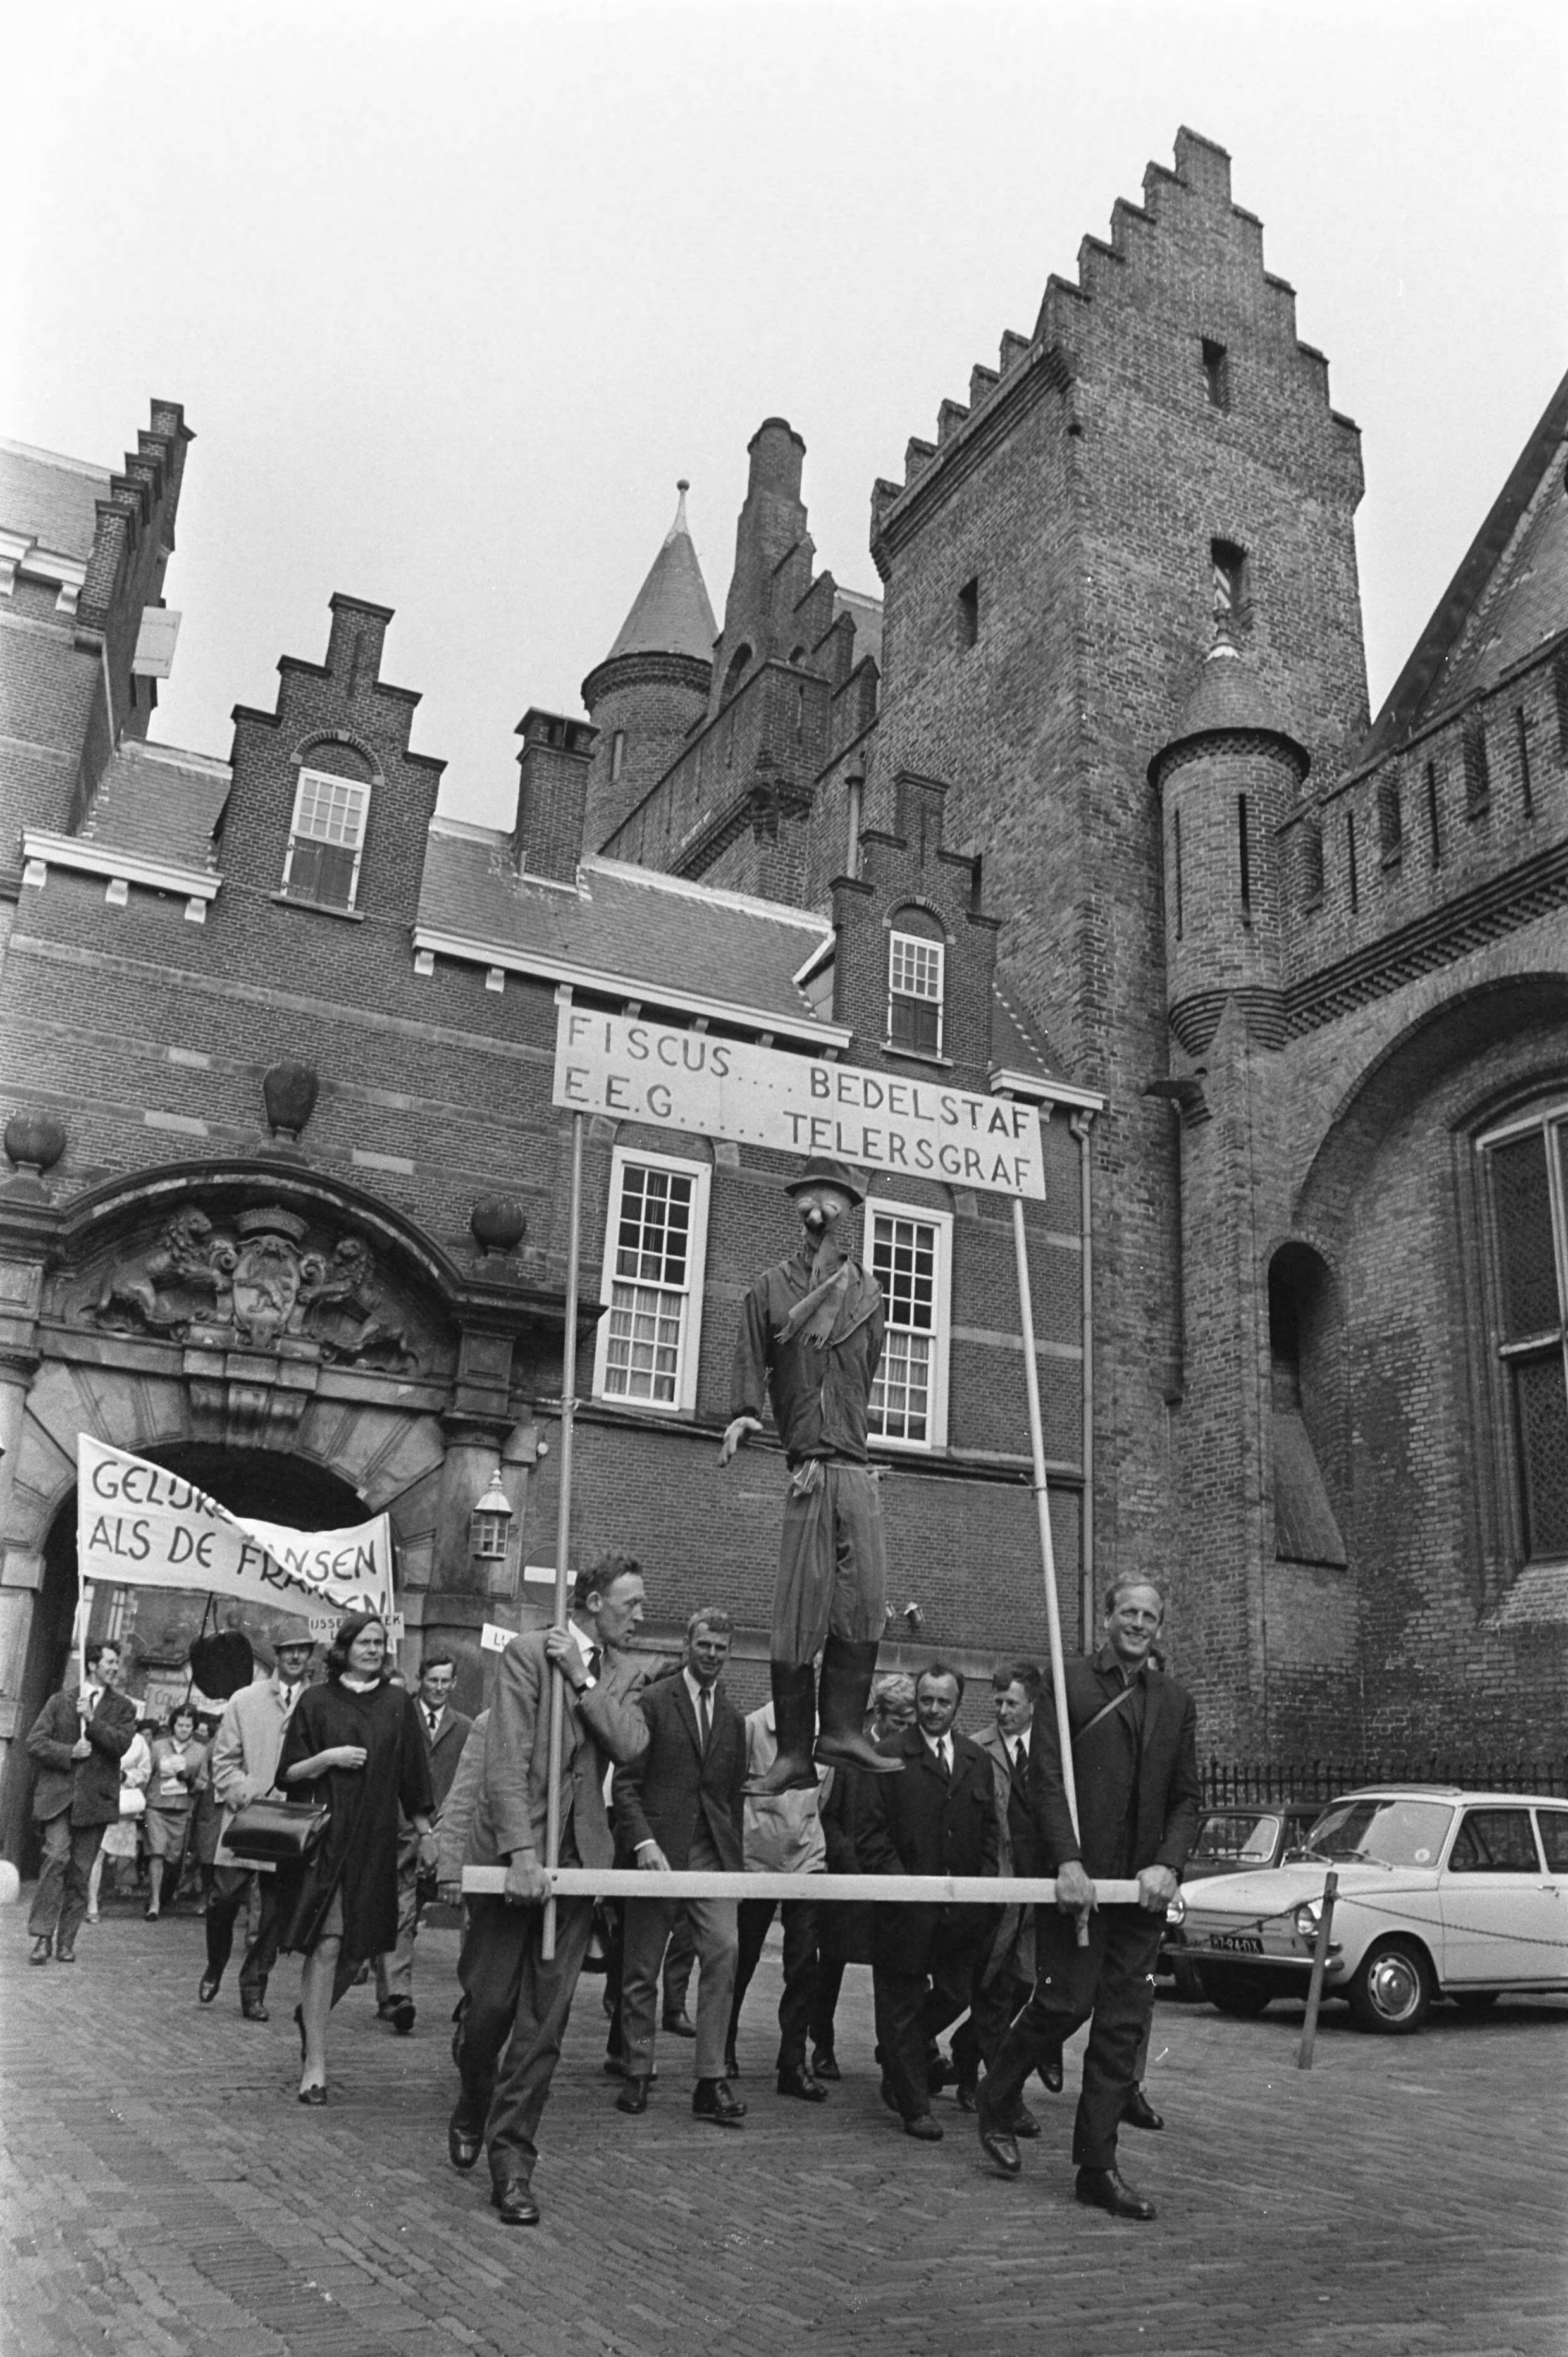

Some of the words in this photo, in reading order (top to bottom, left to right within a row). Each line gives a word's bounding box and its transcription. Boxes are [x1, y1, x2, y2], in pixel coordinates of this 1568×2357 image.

[810, 1066, 1030, 1138] BEDELSTAF
[89, 1516, 151, 1561] ALS
[168, 1525, 216, 1568] DE
